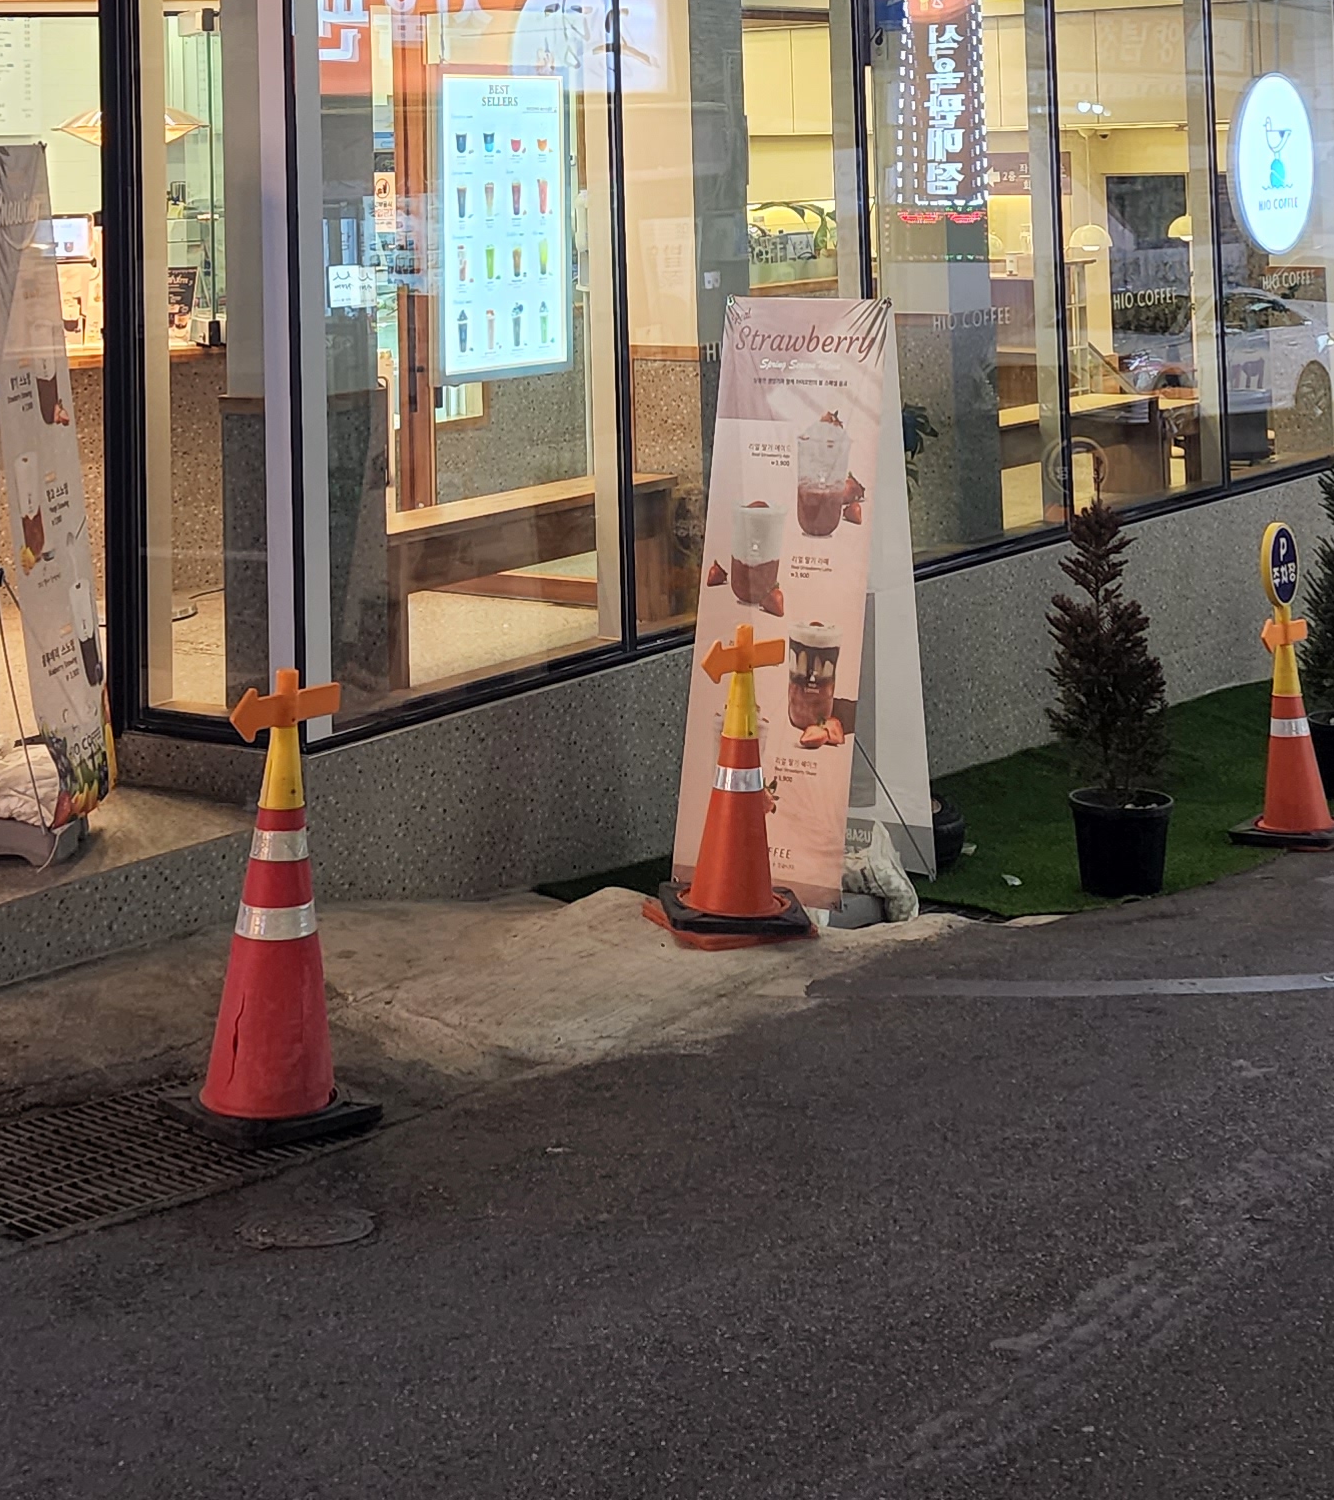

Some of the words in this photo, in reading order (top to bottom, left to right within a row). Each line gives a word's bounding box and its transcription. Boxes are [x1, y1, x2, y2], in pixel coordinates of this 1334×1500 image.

[489, 84, 510, 95] BEST
[482, 97, 518, 107] SELLERS
[1259, 199, 1272, 211] HIO
[1282, 270, 1316, 288] COFFEE
[1113, 292, 1134, 311] HIO
[1137, 287, 1178, 307] COFFEE
[933, 315, 957, 332] HIO
[963, 307, 1011, 329] COFFEE
[735, 325, 877, 363] Strawberry
[1279, 537, 1288, 561] P
[1273, 562, 1296, 587] 주차장
[768, 846, 792, 859] FFEE
